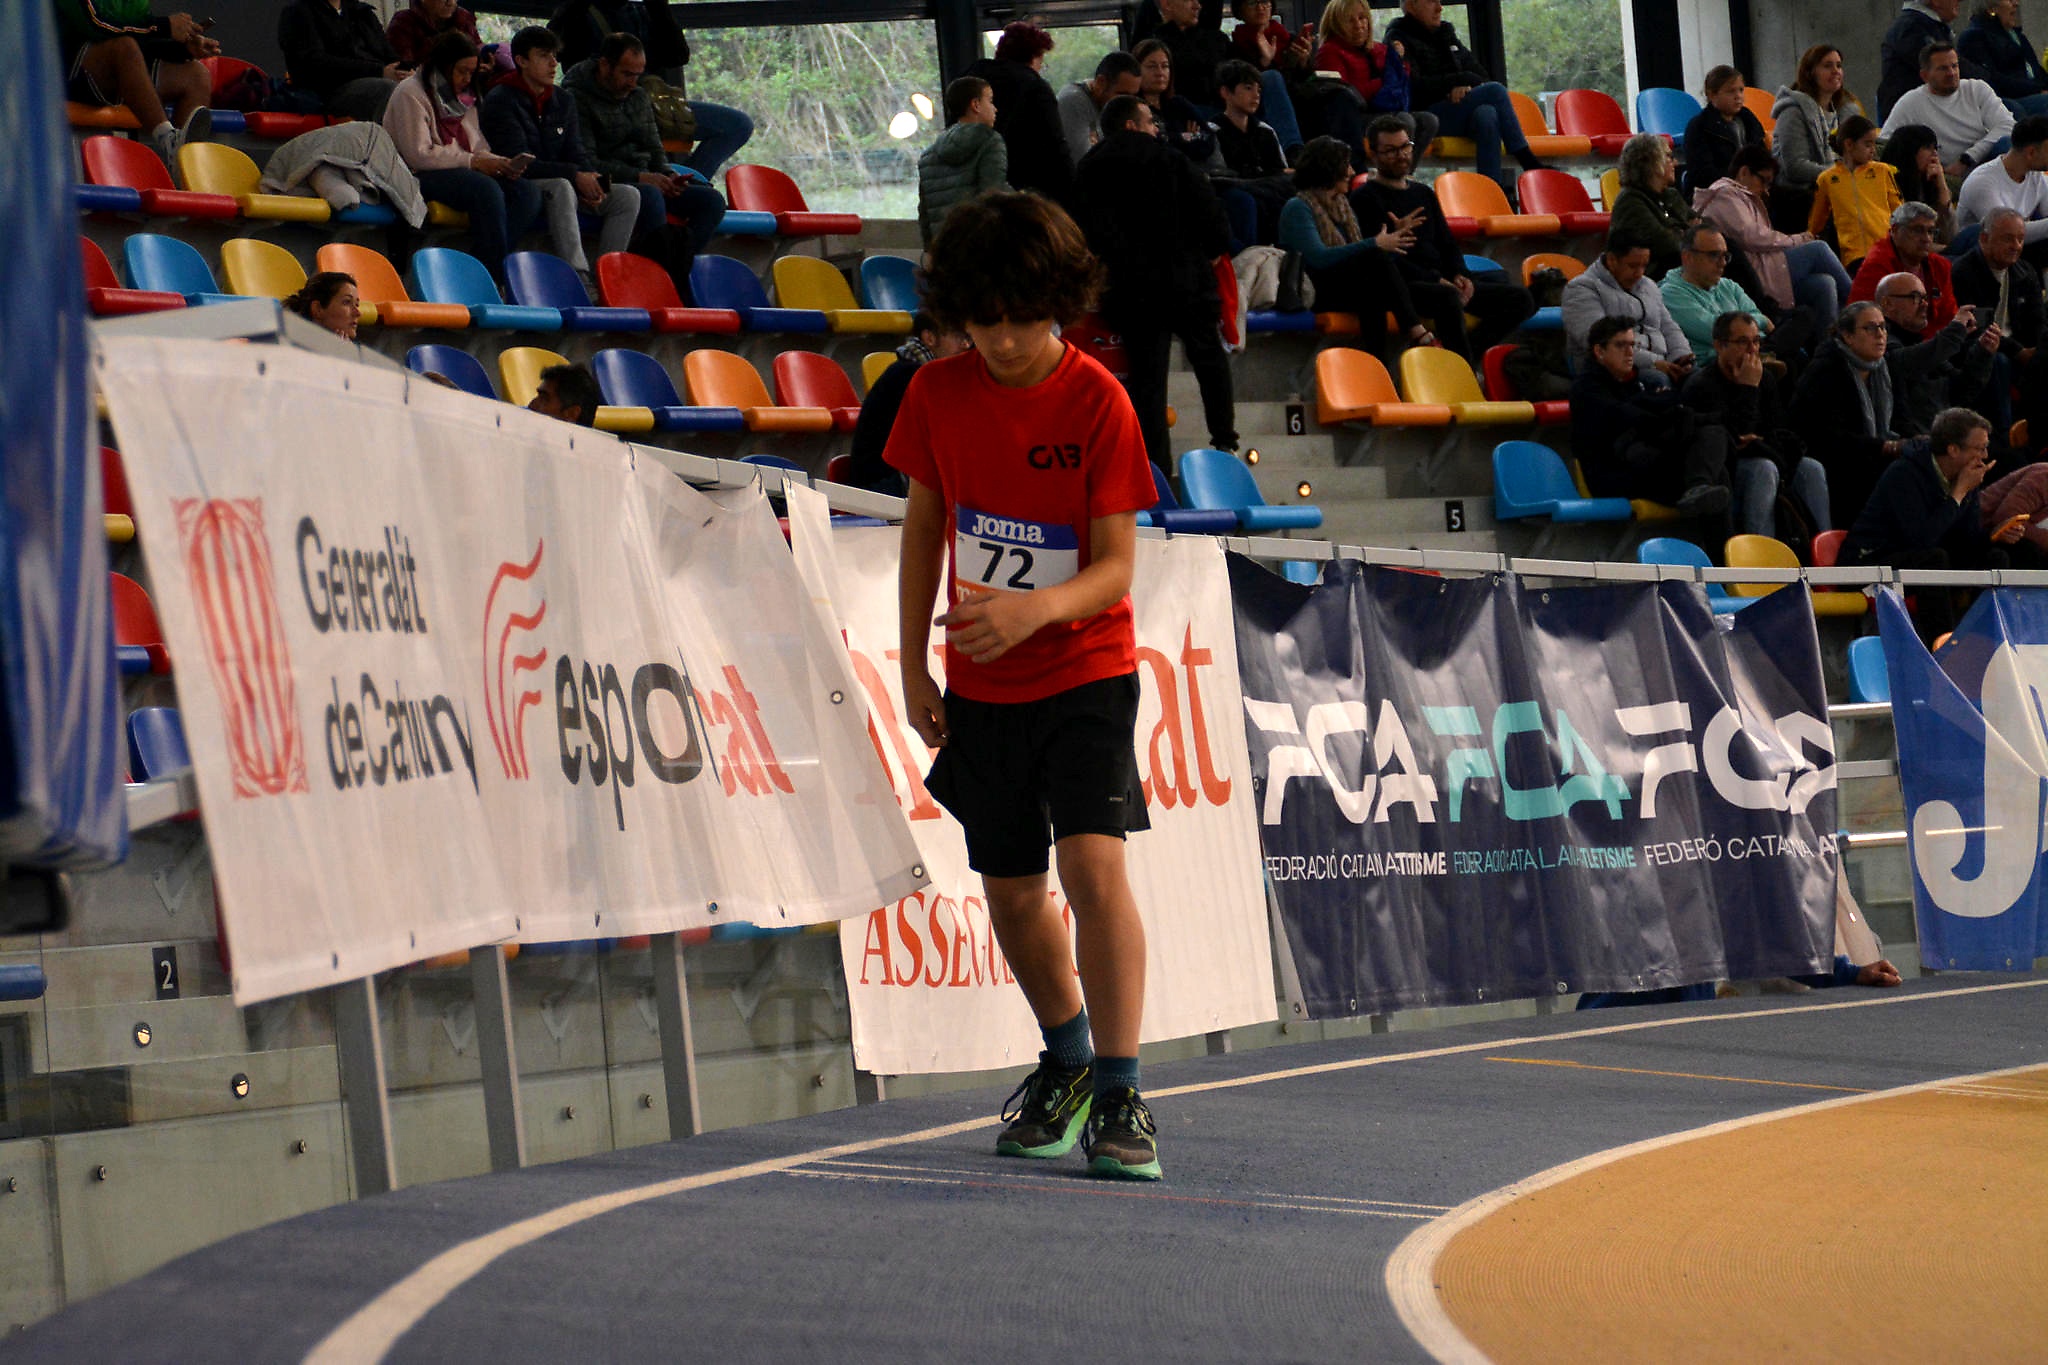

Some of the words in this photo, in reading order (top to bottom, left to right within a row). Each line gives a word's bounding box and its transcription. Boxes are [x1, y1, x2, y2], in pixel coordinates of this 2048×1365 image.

[1291, 414, 1301, 433] 6
[1451, 509, 1462, 529] 5
[979, 541, 1035, 590] 72
[1243, 695, 1439, 825] FCA
[1422, 701, 1632, 823] FCA
[160, 960, 174, 990] 2
